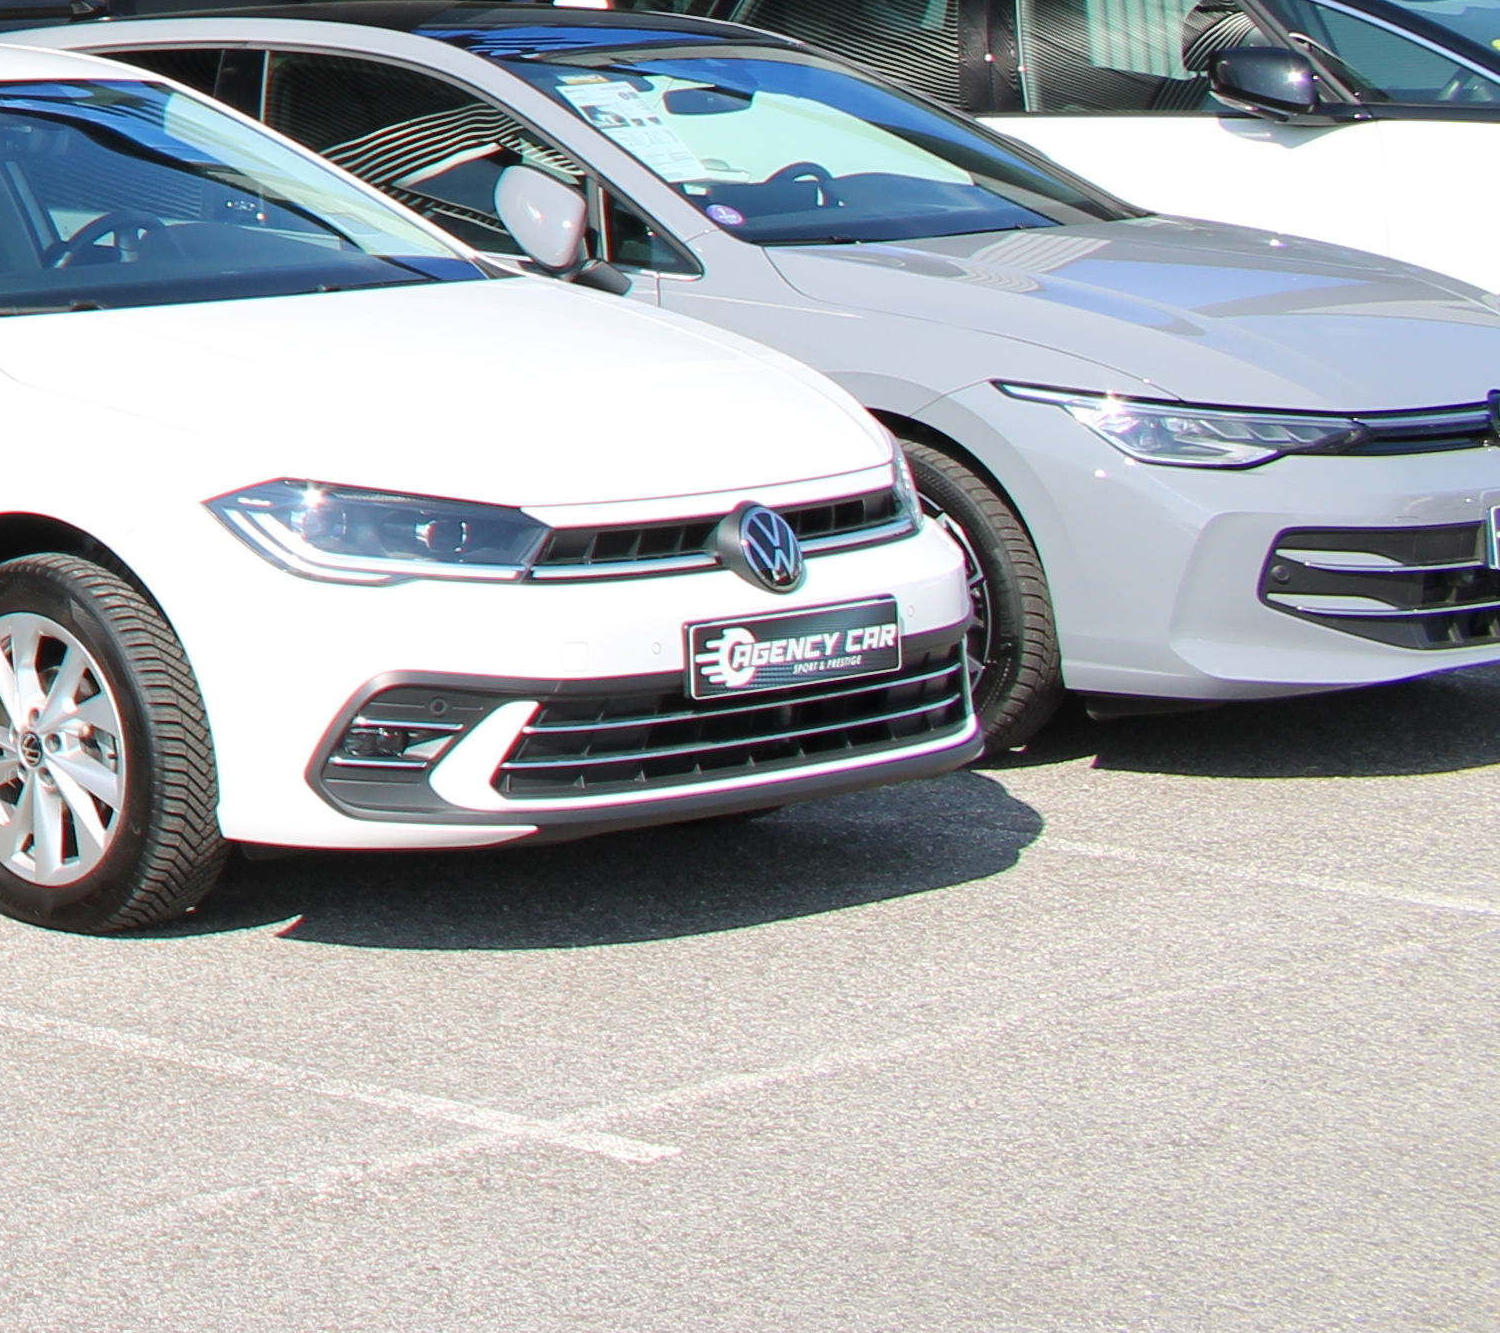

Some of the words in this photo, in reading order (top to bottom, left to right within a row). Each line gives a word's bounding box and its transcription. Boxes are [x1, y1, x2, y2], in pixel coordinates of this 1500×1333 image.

[732, 631, 841, 669] AGENCY
[844, 623, 898, 653] CAR
[792, 661, 818, 676] SPORT
[826, 654, 863, 670] PRESTIGE
